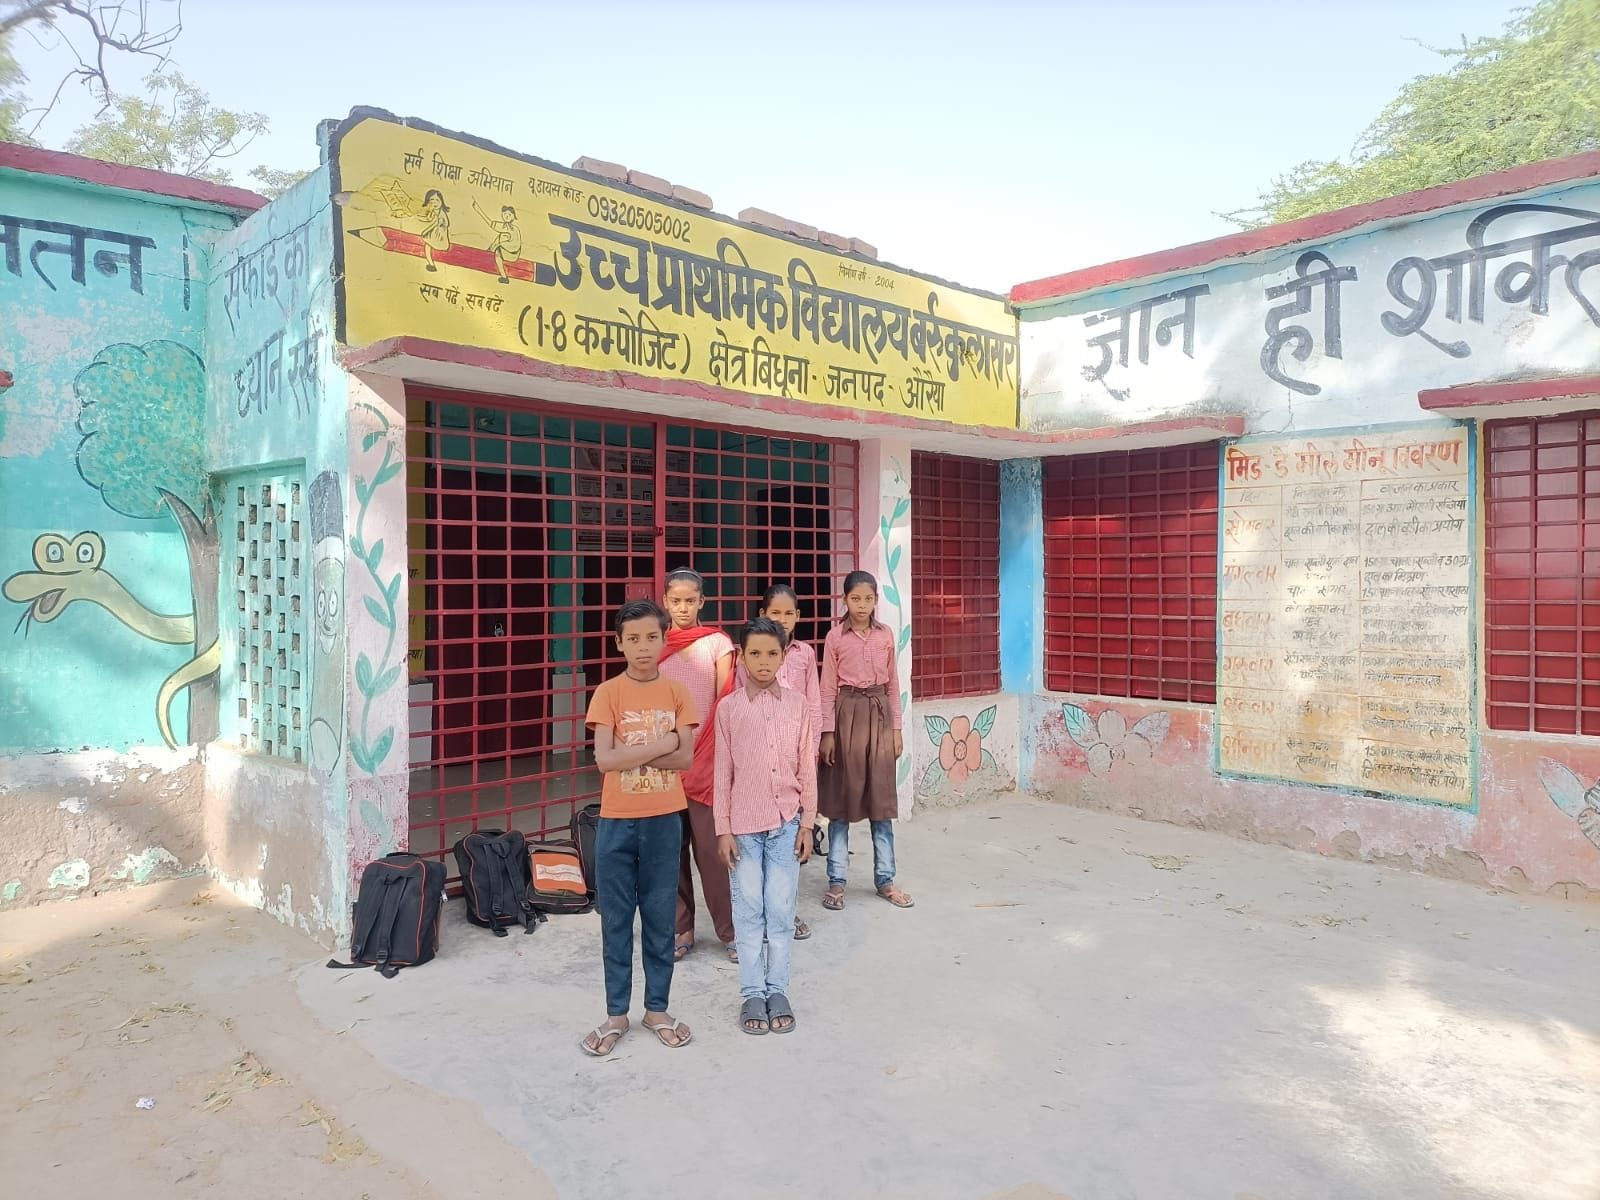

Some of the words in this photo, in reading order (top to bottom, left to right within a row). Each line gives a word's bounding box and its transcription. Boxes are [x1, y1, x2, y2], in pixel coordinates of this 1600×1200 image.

[404, 148, 424, 174] सर्व
[432, 152, 463, 185] शिक्षा
[467, 167, 514, 195] अभियान
[587, 194, 691, 243] 09320505002
[419, 282, 443, 303] सब
[465, 293, 485, 310] सब
[548, 213, 651, 307] उच्च
[651, 237, 788, 334] प्राथमिक
[788, 257, 911, 364] विद्यालय
[875, 275, 895, 291] 2004
[1260, 250, 1358, 395] ही
[708, 327, 749, 386] क्षेत्र
[639, 777, 650, 789] 10
